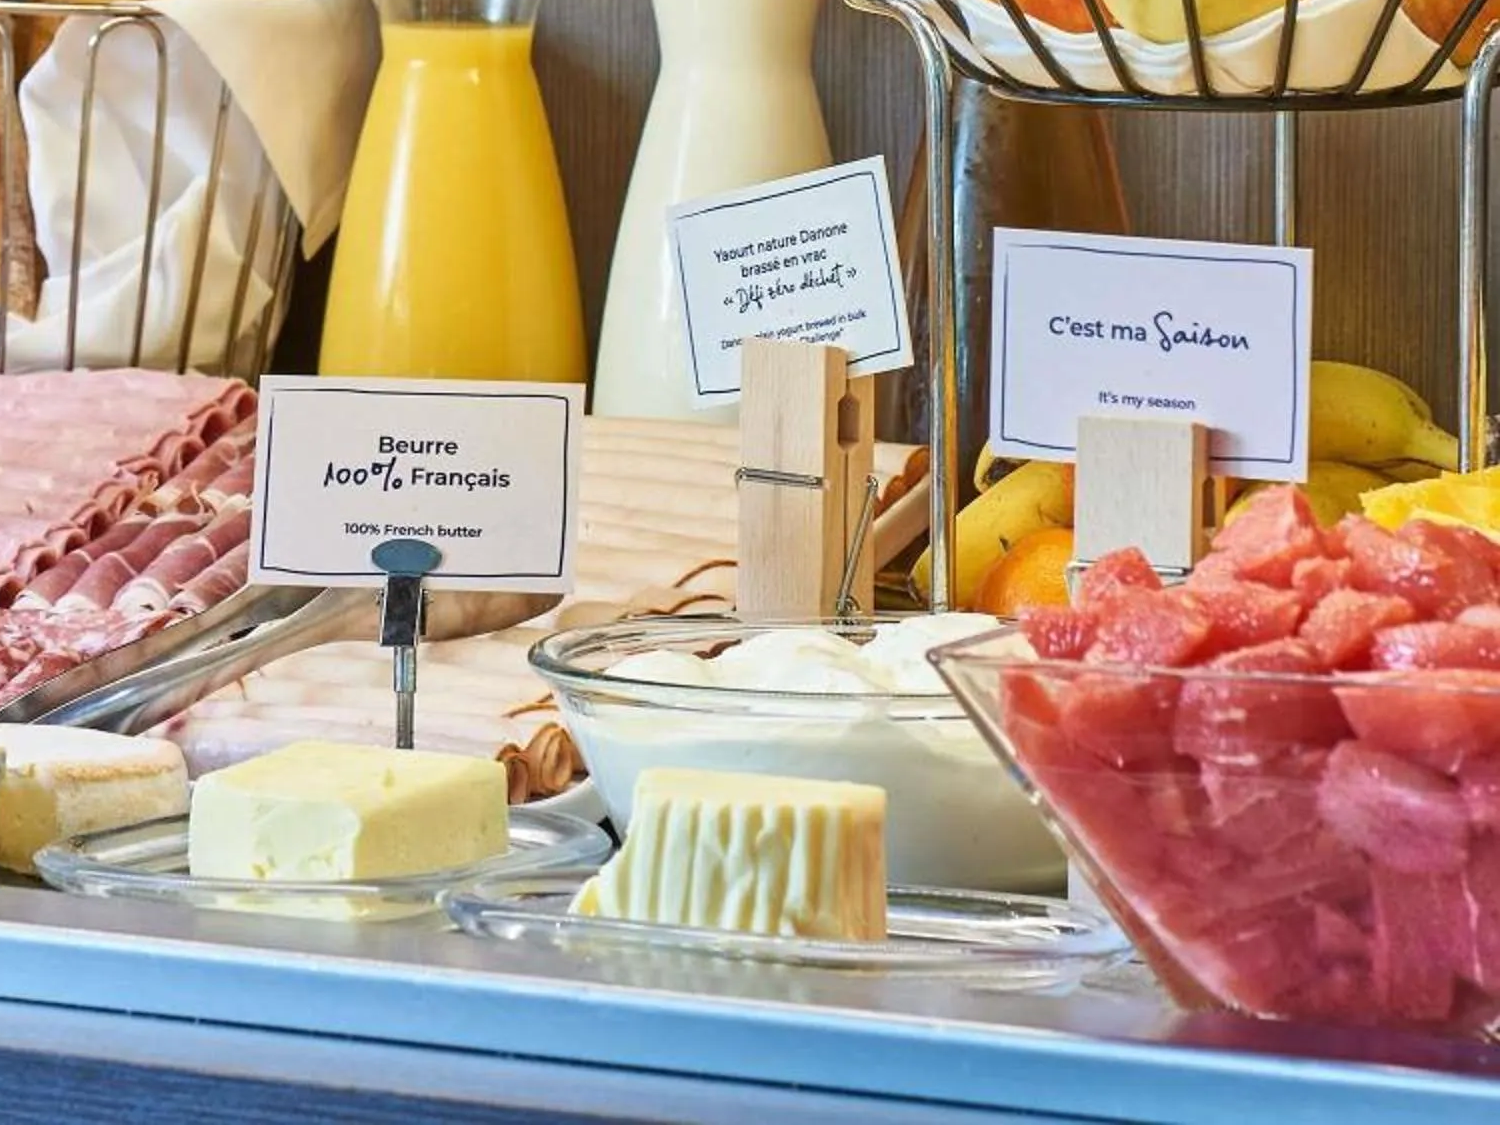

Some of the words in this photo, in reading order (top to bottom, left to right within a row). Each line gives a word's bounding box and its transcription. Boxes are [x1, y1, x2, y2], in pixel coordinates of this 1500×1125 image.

[713, 243, 756, 264] Yaourt
[757, 235, 798, 255] nature
[799, 222, 849, 244] Danone
[740, 255, 781, 278] brassé
[783, 255, 799, 268] en
[801, 248, 828, 264] vrac
[735, 284, 765, 314] Défi
[767, 277, 796, 300] zéro
[799, 262, 844, 290] déchet
[776, 324, 804, 340] yogurt
[838, 314, 847, 323] in
[847, 309, 867, 322] bulk
[1048, 316, 1105, 339] C'est
[1111, 323, 1148, 342] ma
[1153, 310, 1251, 352] Saison
[1098, 391, 1119, 405] It's
[1121, 394, 1145, 409] my
[1147, 397, 1197, 411] season
[378, 435, 459, 456] Beurre
[323, 456, 403, 491] 100%
[411, 468, 511, 492] Français
[344, 522, 381, 535] 100%
[383, 523, 434, 537] French
[437, 525, 483, 538] butter
